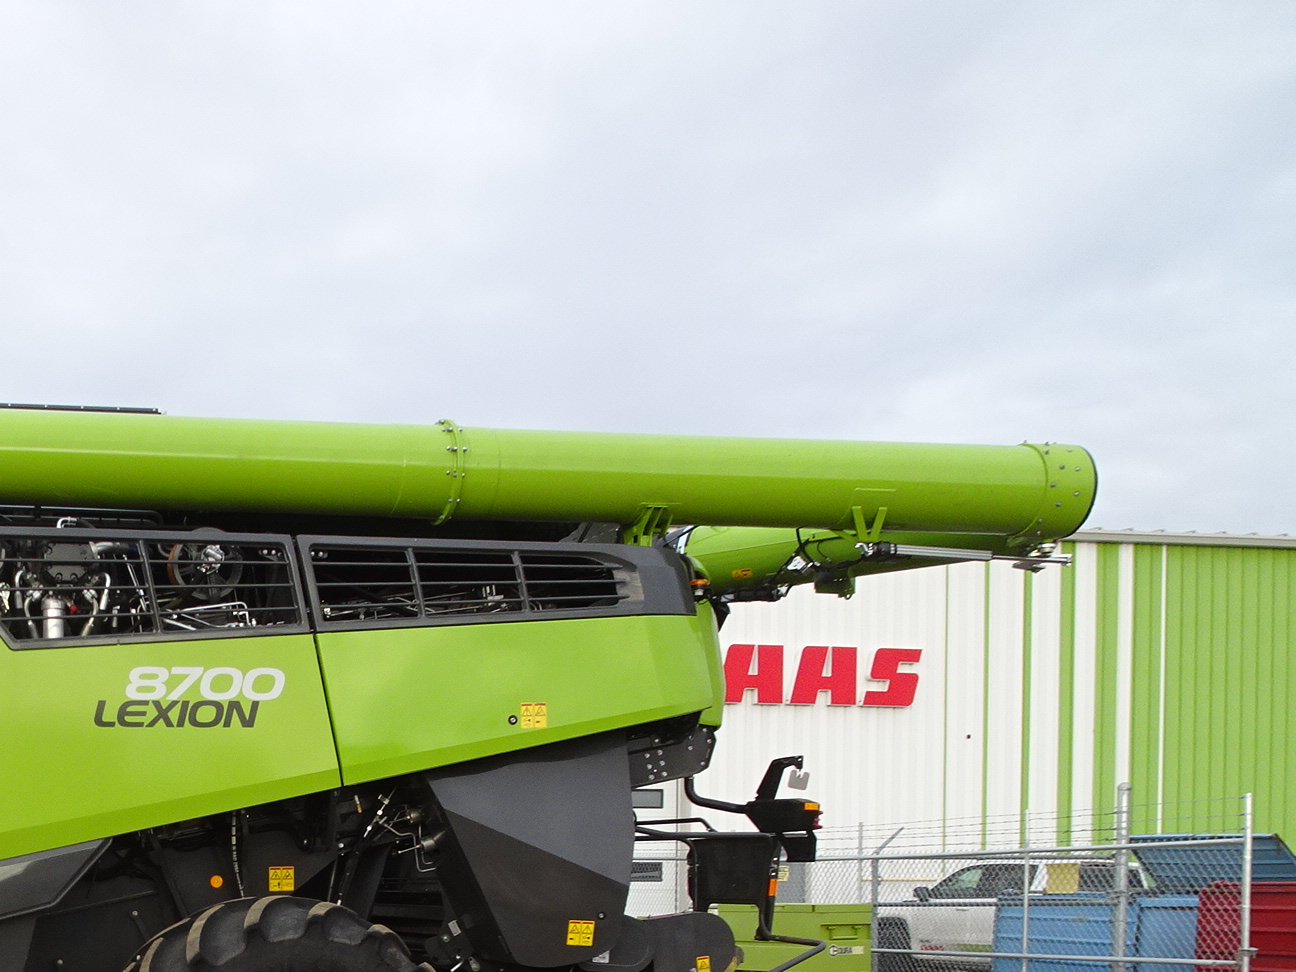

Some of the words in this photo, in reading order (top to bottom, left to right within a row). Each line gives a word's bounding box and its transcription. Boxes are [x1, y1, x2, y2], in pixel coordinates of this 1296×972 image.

[125, 666, 286, 701] 8700
[724, 643, 923, 707] AAS
[94, 700, 260, 728] LEXION
